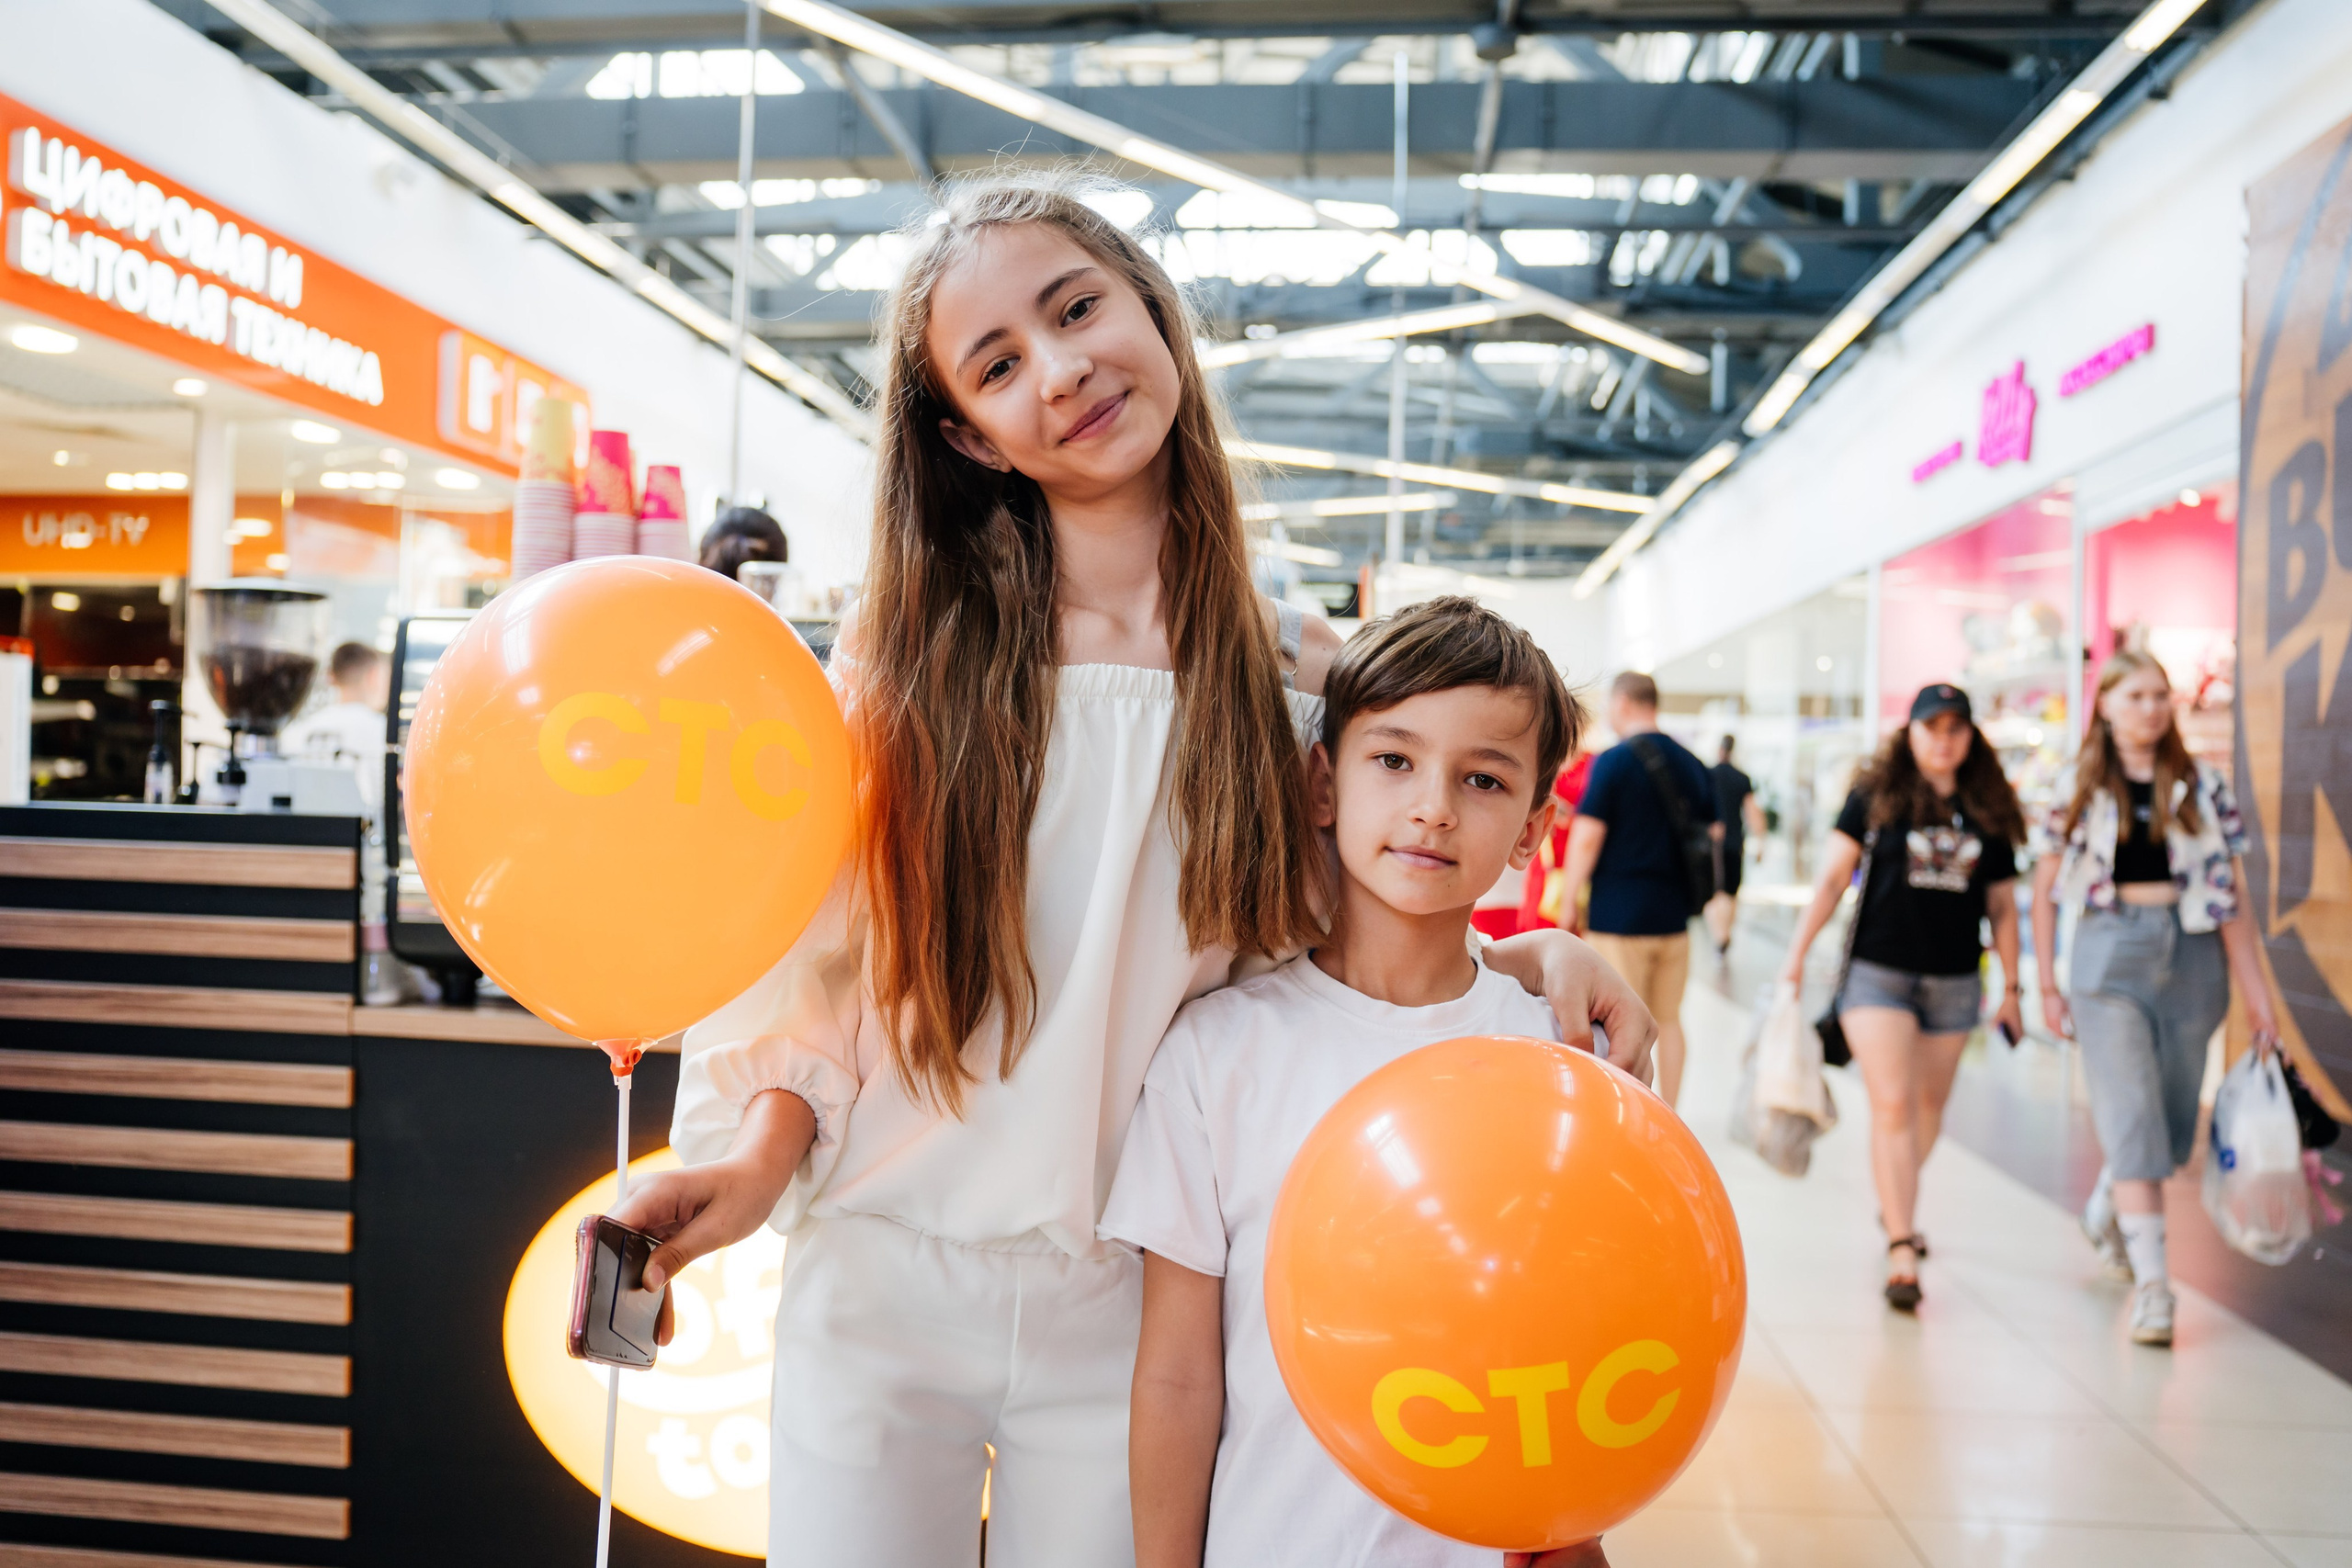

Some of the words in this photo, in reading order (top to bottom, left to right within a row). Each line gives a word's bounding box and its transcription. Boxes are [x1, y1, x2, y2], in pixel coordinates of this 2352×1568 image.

[23, 126, 267, 294] ЦИФРОВАЯ
[269, 245, 304, 310] И
[20, 205, 229, 346] БЫТОВАЯ
[231, 295, 384, 406] ТЕХНИКА
[22, 511, 150, 548] UHD-TV
[537, 692, 813, 822] СТС
[1371, 1338, 1682, 1469] СТС
